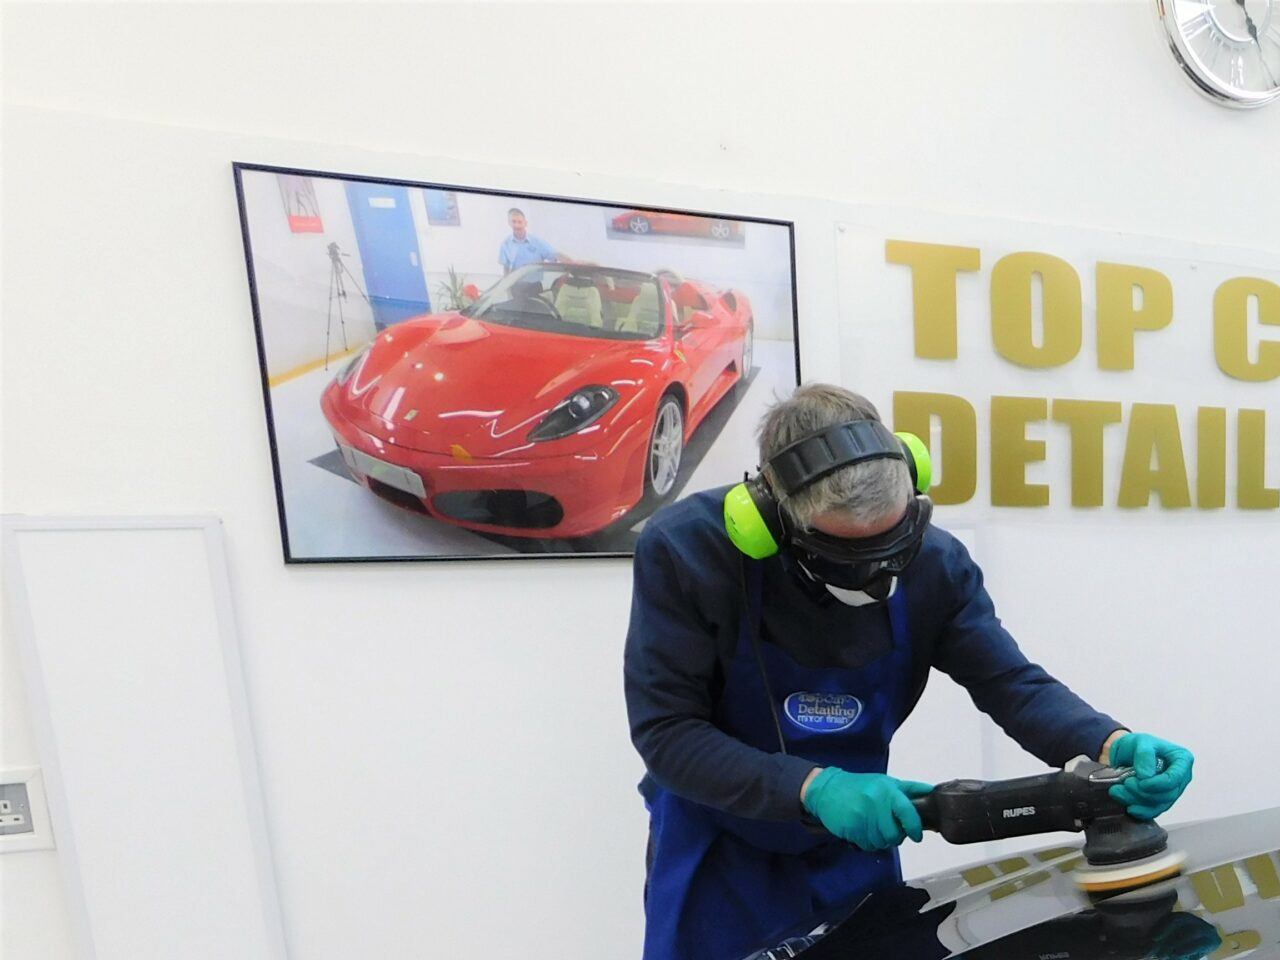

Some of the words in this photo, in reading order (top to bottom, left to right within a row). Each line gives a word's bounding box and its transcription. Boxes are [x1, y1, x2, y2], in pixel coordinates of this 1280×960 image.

[885, 239, 1174, 371] TOP
[798, 703, 856, 719] Detailing
[1002, 806, 1036, 819] RUPES
